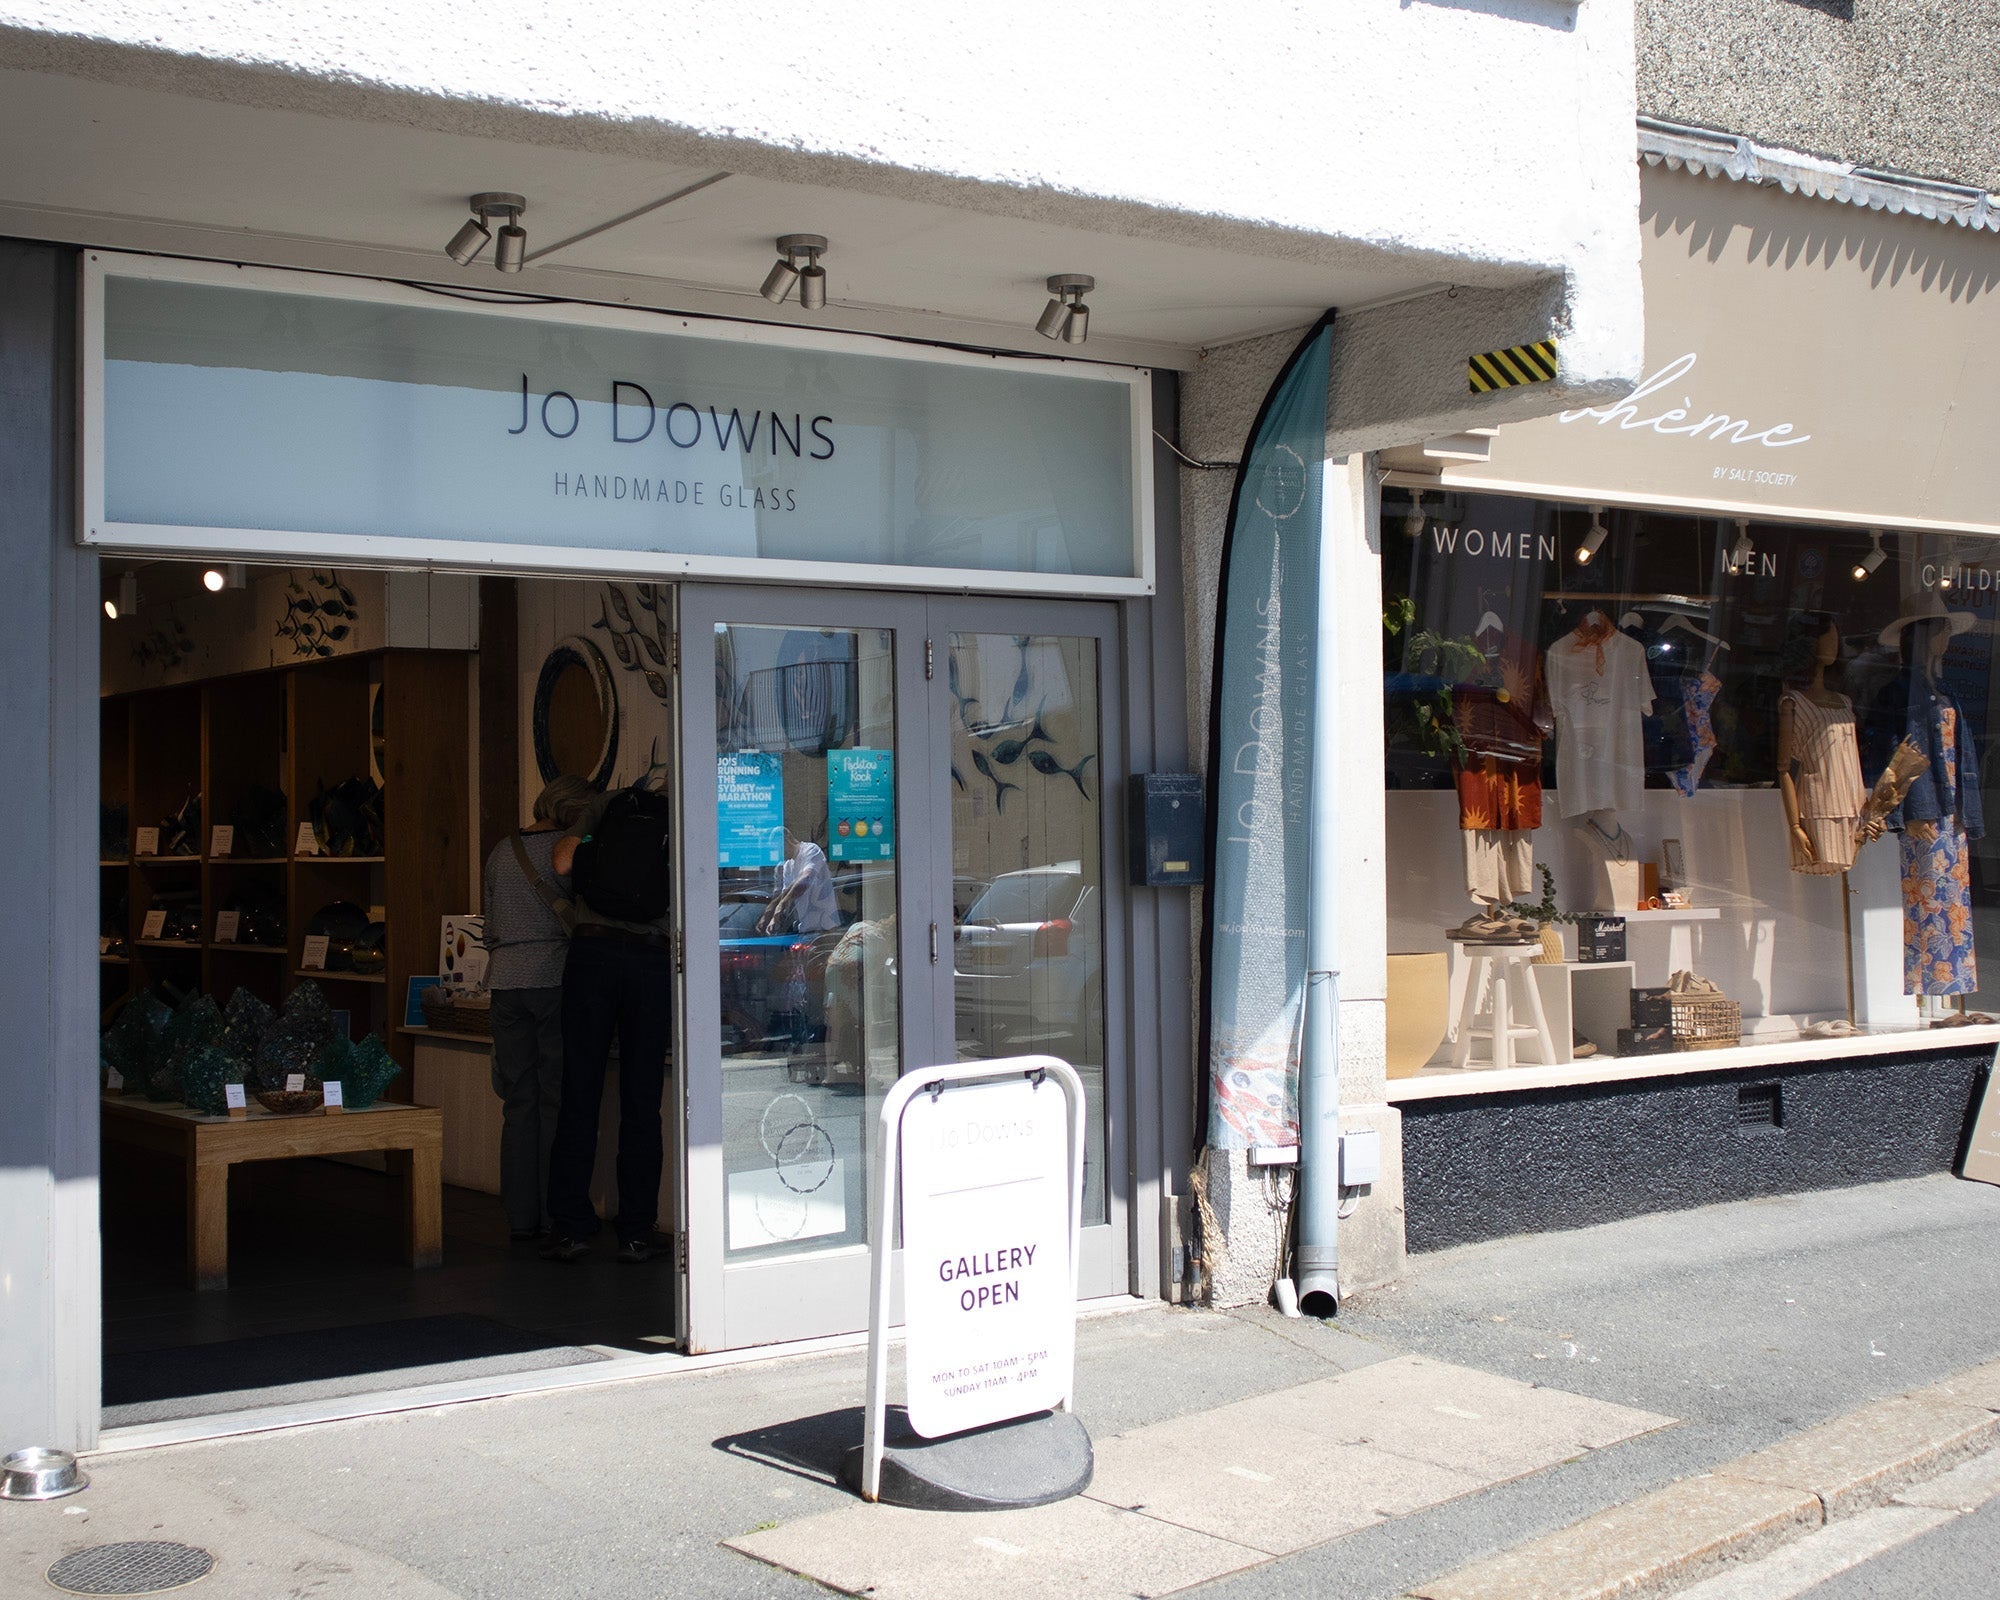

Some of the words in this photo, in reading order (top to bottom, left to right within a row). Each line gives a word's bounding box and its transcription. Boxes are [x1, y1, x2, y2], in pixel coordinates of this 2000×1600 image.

[1713, 466, 1728, 479] BY
[1729, 468, 1754, 482] SALT
[1755, 471, 1798, 486] SOCIETY
[555, 472, 704, 505] HANDMADE
[720, 484, 797, 512] GLASS
[1433, 526, 1555, 561] WOMEN
[1721, 549, 1777, 577] MEN
[1296, 632, 1309, 696] GLASS
[717, 757, 738, 766] JO'S
[717, 766, 760, 775] RUNNING
[1289, 706, 1306, 824] HANDMADE
[717, 775, 736, 784] THE
[717, 783, 755, 793] SYDNEY
[717, 792, 772, 802] MARATHON
[1594, 920, 1625, 933] Marshall
[939, 1244, 1037, 1282] GALLERY
[960, 1280, 1019, 1311] OPEN
[932, 1371, 955, 1384] MON
[958, 1367, 970, 1378] TO
[972, 1362, 989, 1375] SAT
[993, 1356, 1018, 1370] 10AM
[1027, 1350, 1048, 1365] 5PM
[943, 1382, 981, 1397] SUNDAY
[984, 1375, 1008, 1389] 11AM
[1017, 1368, 1038, 1382] 4PM
